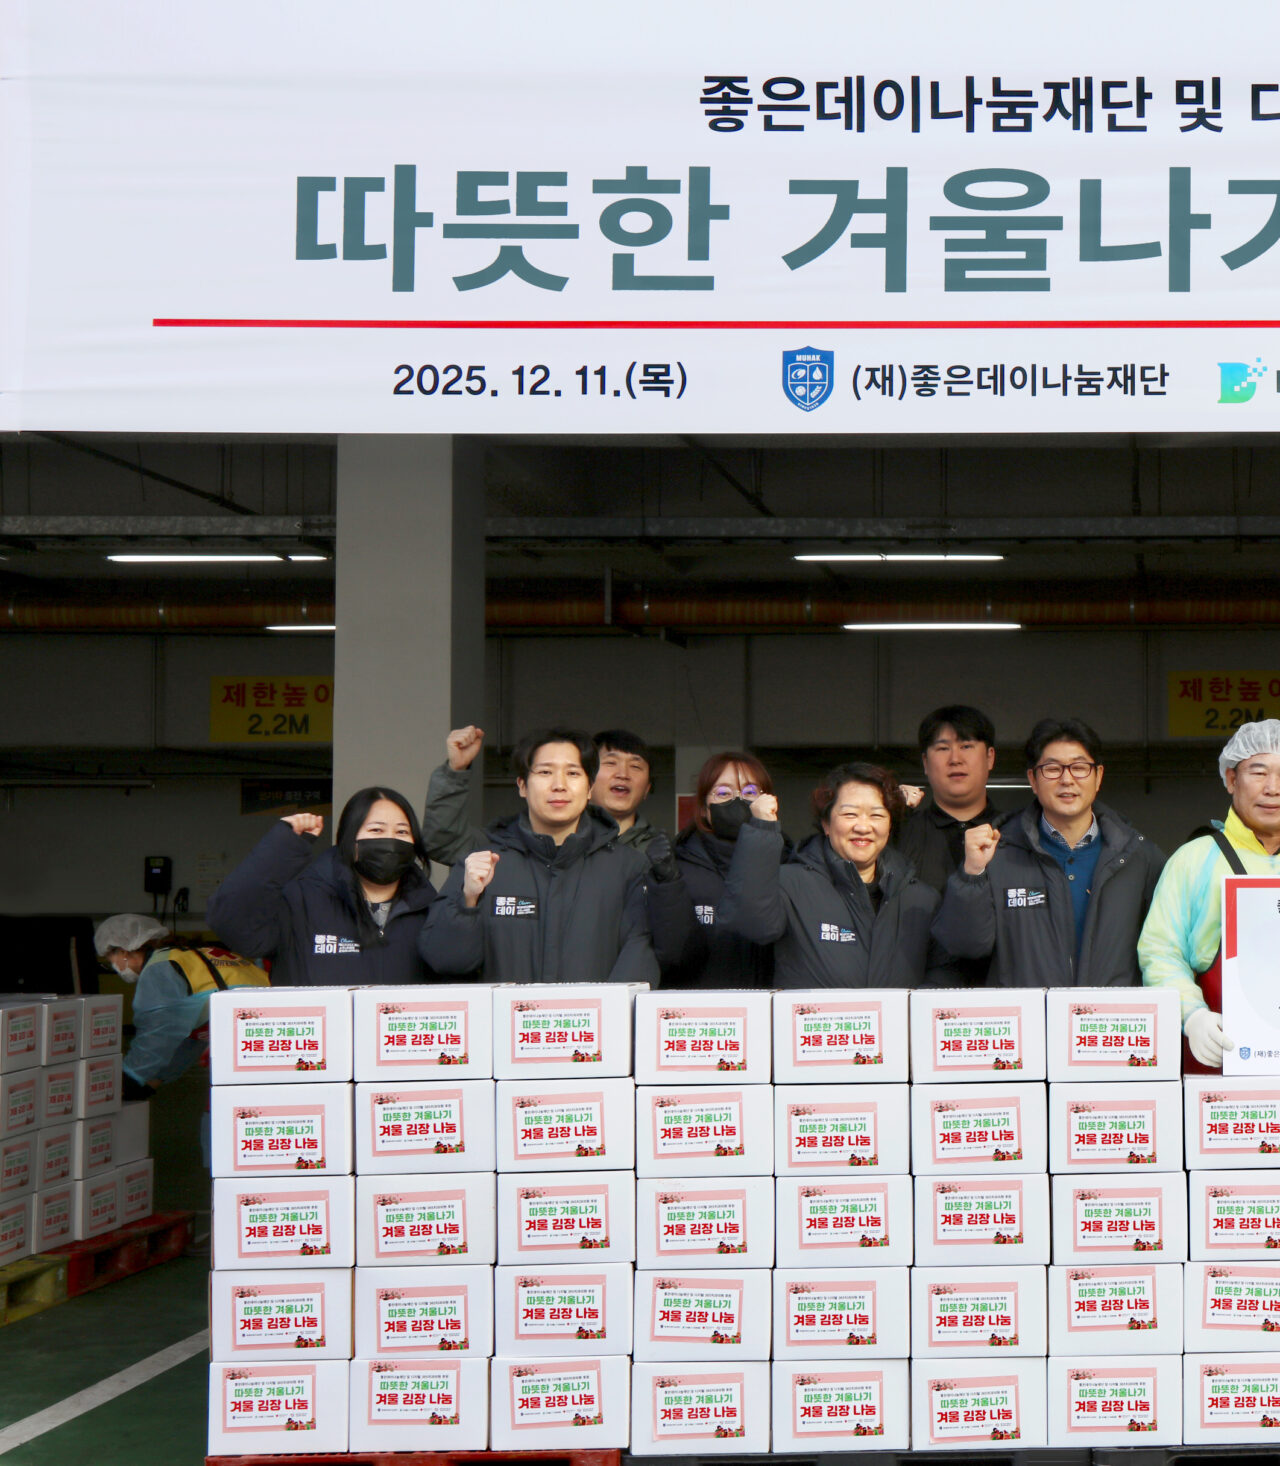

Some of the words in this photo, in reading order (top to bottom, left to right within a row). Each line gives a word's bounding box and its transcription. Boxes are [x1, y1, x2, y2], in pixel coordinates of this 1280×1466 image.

[700, 75, 1153, 133] 좋은데이나눔재단
[1175, 77, 1223, 133] 및
[296, 164, 730, 292] 따뜻한
[393, 364, 498, 397] 2025.
[512, 365, 561, 397] 12.
[575, 361, 687, 399] 11.(목)
[852, 363, 1169, 401] (재)좋은데이나눔재단
[248, 713, 309, 736] 2.2M
[245, 1027, 273, 1038] 따뜻한
[667, 1027, 697, 1038] 따뜻한
[943, 1027, 972, 1038] 따뜻한
[241, 1039, 264, 1051] 겨울
[268, 1039, 293, 1051] 김장
[295, 1039, 319, 1050] 나눔
[663, 1039, 687, 1051] 겨울
[690, 1039, 714, 1051] 김장
[716, 1039, 740, 1051] 나눔
[940, 1039, 963, 1051] 겨울
[966, 1039, 990, 1051] 김장
[992, 1039, 1015, 1050] 나눔
[943, 1201, 973, 1212] 따뜻한
[248, 1213, 278, 1224] 따뜻한
[940, 1213, 963, 1225] 겨울
[967, 1213, 991, 1225] 김장
[993, 1212, 1017, 1224] 나눔
[245, 1225, 268, 1237] 겨울
[272, 1224, 296, 1236] 김장
[299, 1223, 323, 1235] 나눔
[525, 1295, 555, 1306] 따뜻한
[522, 1307, 545, 1319] 겨울
[549, 1307, 573, 1319] 김장
[575, 1307, 599, 1319] 나눔
[234, 1387, 263, 1398] 따뜻한
[1211, 1384, 1240, 1395] 따뜻한
[230, 1400, 254, 1412] 겨울
[257, 1399, 281, 1411] 김장
[284, 1398, 309, 1409] 나눔
[664, 1395, 693, 1406] 따뜻한
[940, 1398, 969, 1409] 따뜻한
[1207, 1396, 1230, 1408] 겨울
[1233, 1396, 1257, 1408] 김장
[660, 1408, 683, 1420] 겨울
[687, 1407, 711, 1419] 김장
[713, 1406, 737, 1417] 나눔
[936, 1410, 960, 1422] 겨울
[963, 1409, 987, 1421] 김장
[989, 1408, 1013, 1420] 나눔
